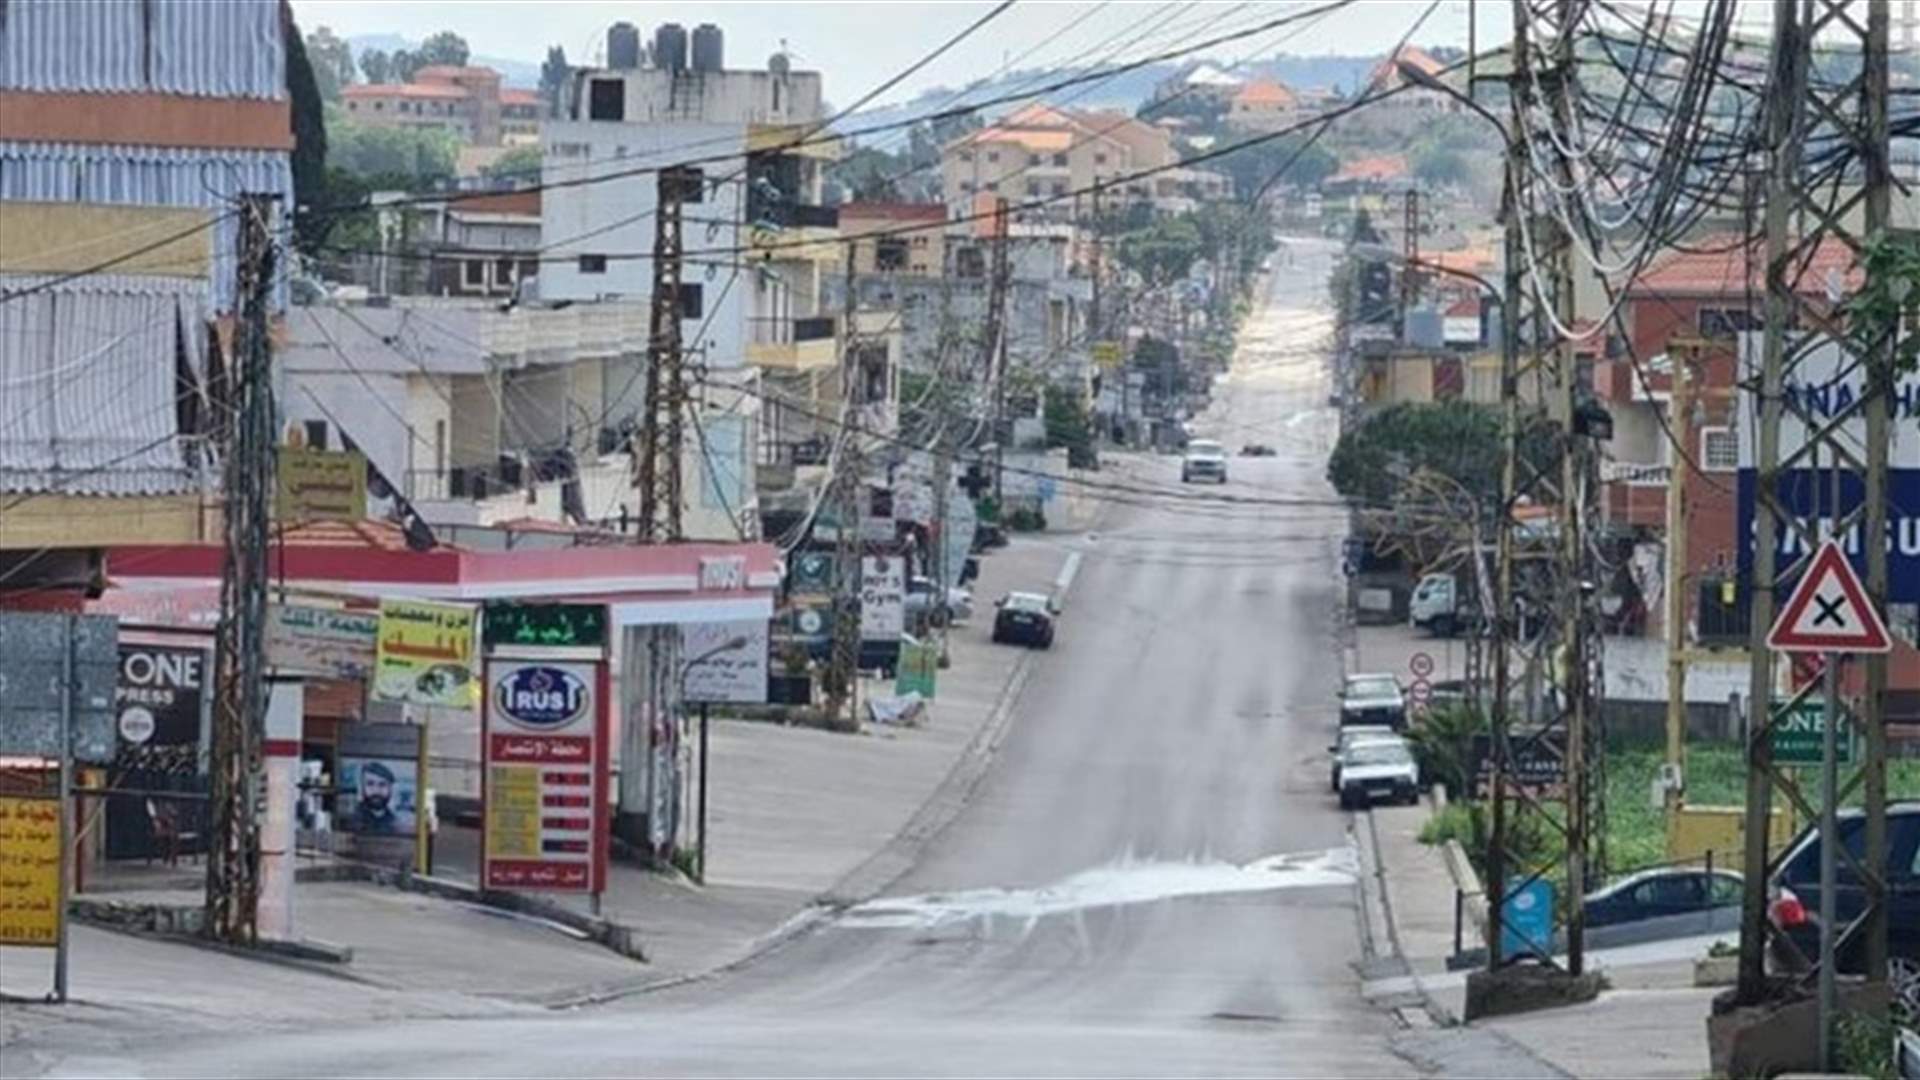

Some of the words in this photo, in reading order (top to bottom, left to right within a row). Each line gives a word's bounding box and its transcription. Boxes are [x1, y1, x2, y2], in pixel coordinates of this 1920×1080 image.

[863, 589, 901, 607] Gym
[124, 653, 201, 689] ONE
[501, 673, 581, 711] TRUST
